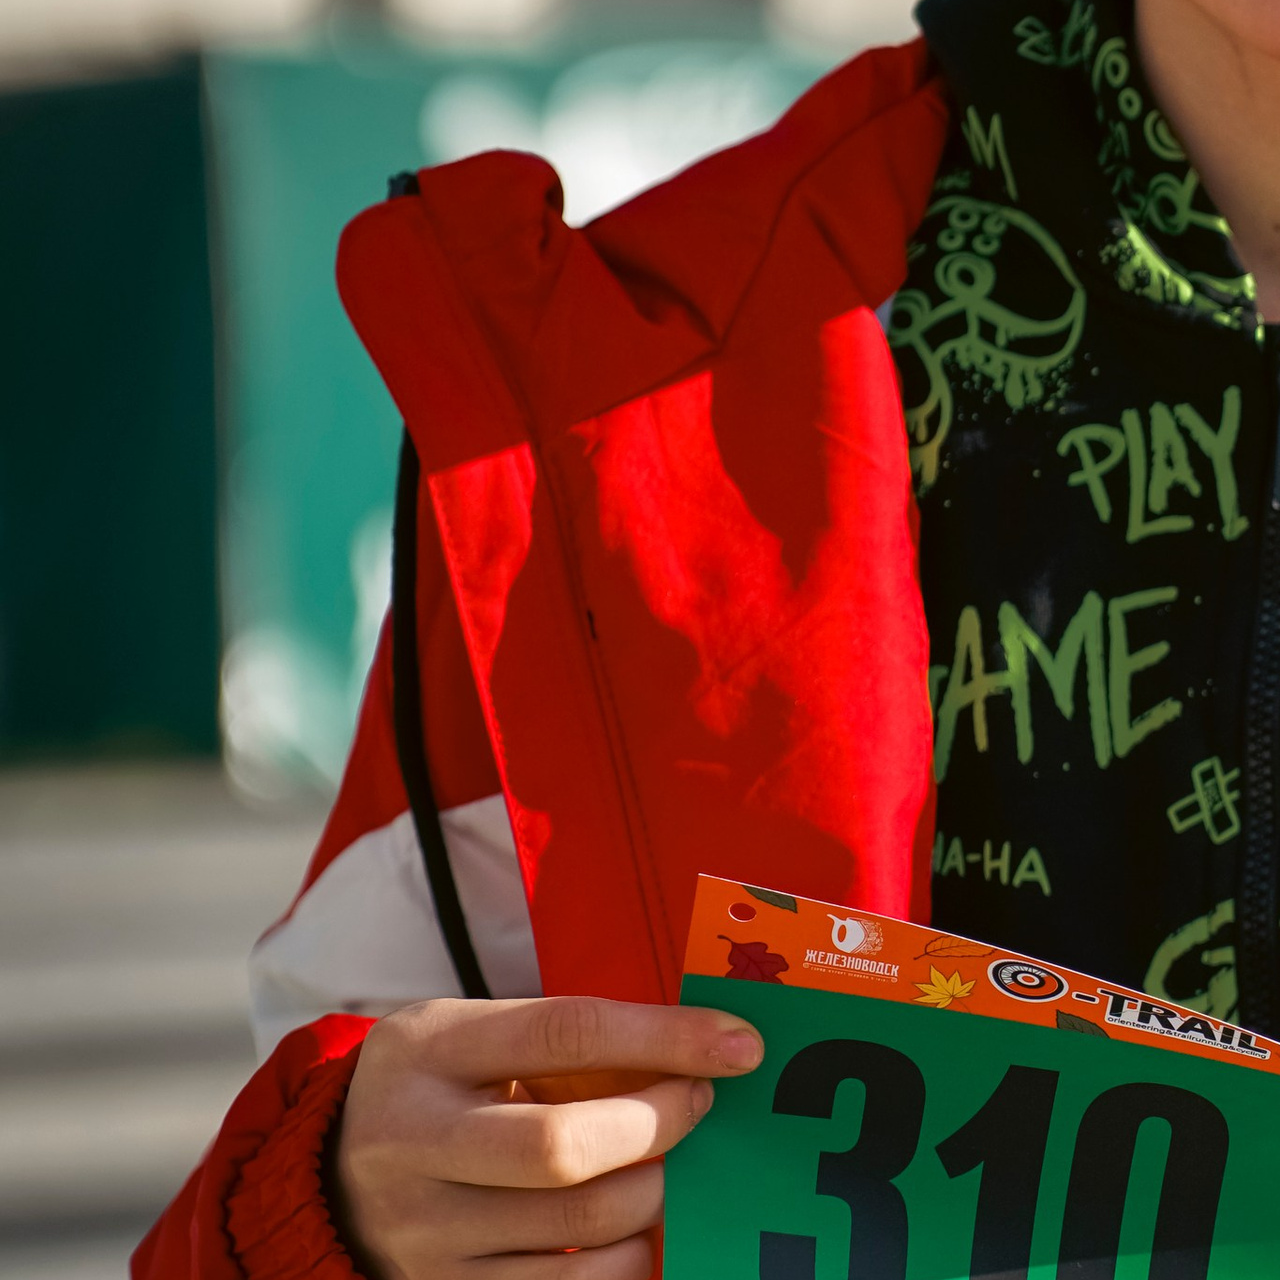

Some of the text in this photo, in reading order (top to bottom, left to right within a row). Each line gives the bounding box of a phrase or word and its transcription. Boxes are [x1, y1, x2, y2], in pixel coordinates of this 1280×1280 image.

[1057, 385, 1250, 542] PLAY
[929, 587, 1183, 784] AME
[804, 949, 900, 977] ЖЕЛЕЗНОВОДСК
